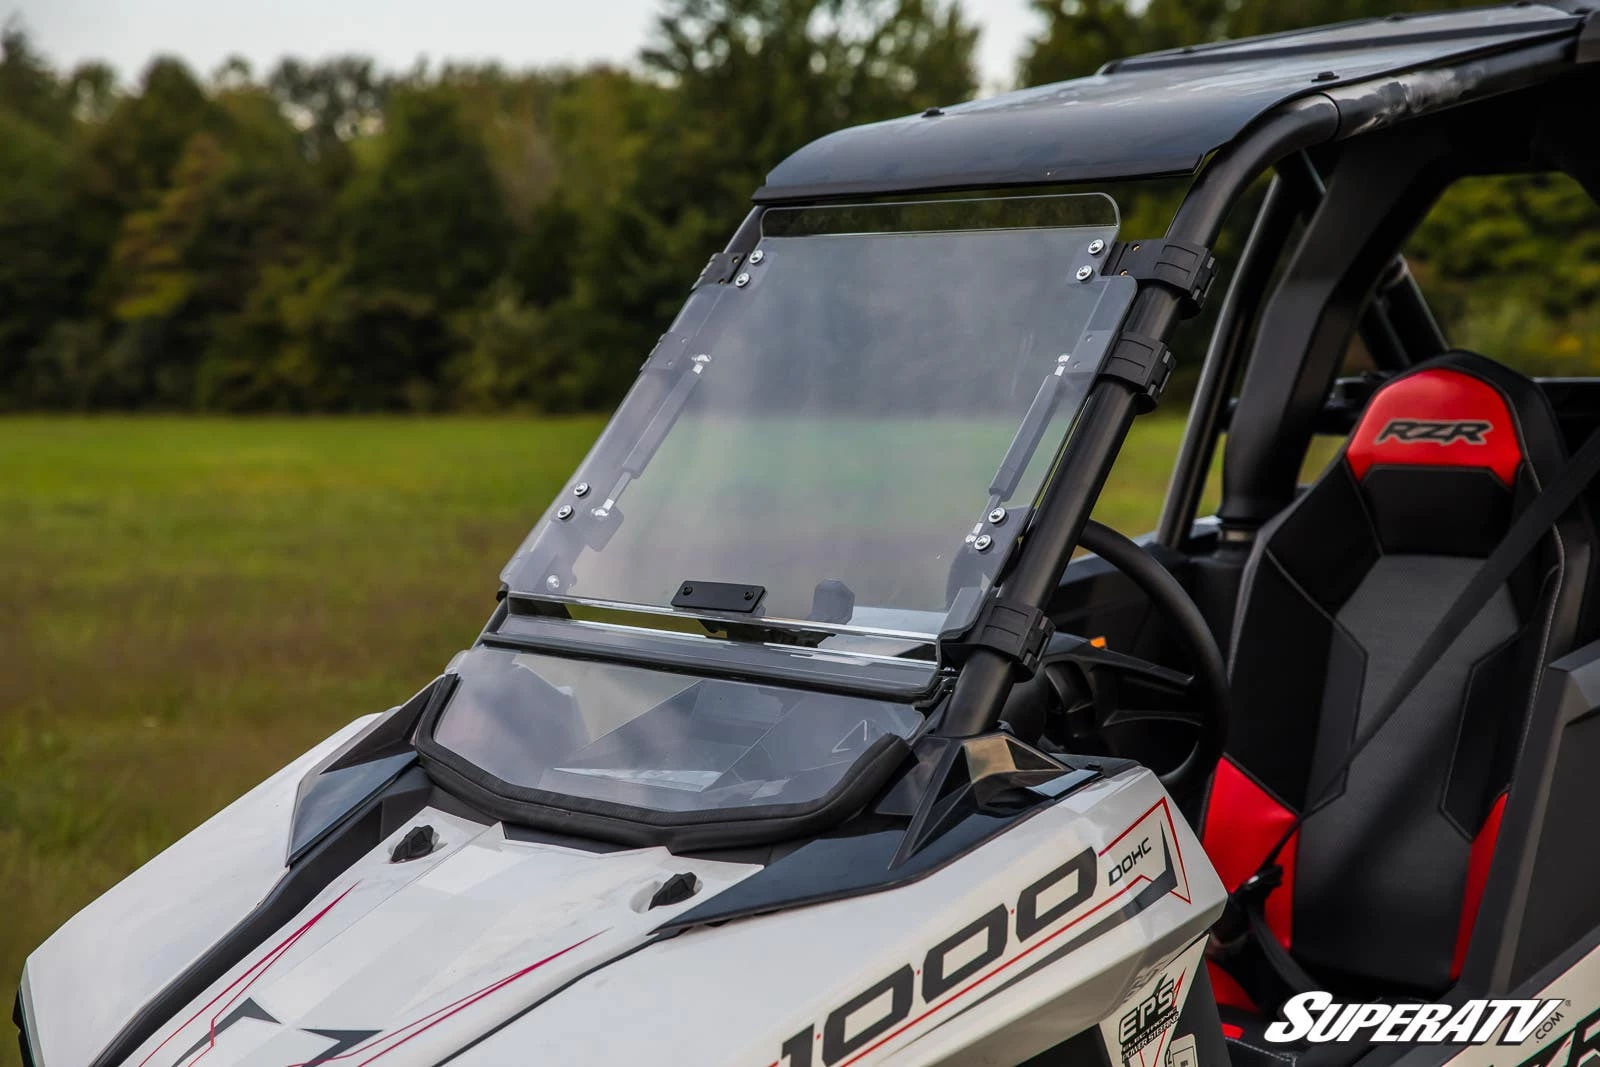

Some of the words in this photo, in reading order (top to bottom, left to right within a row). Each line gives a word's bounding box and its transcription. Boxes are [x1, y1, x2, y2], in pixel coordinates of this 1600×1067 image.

[1374, 418, 1493, 445] RZR
[1109, 837, 1151, 886] DOHC
[781, 846, 1098, 1067] 1000
[1119, 977, 1175, 1045] EPS
